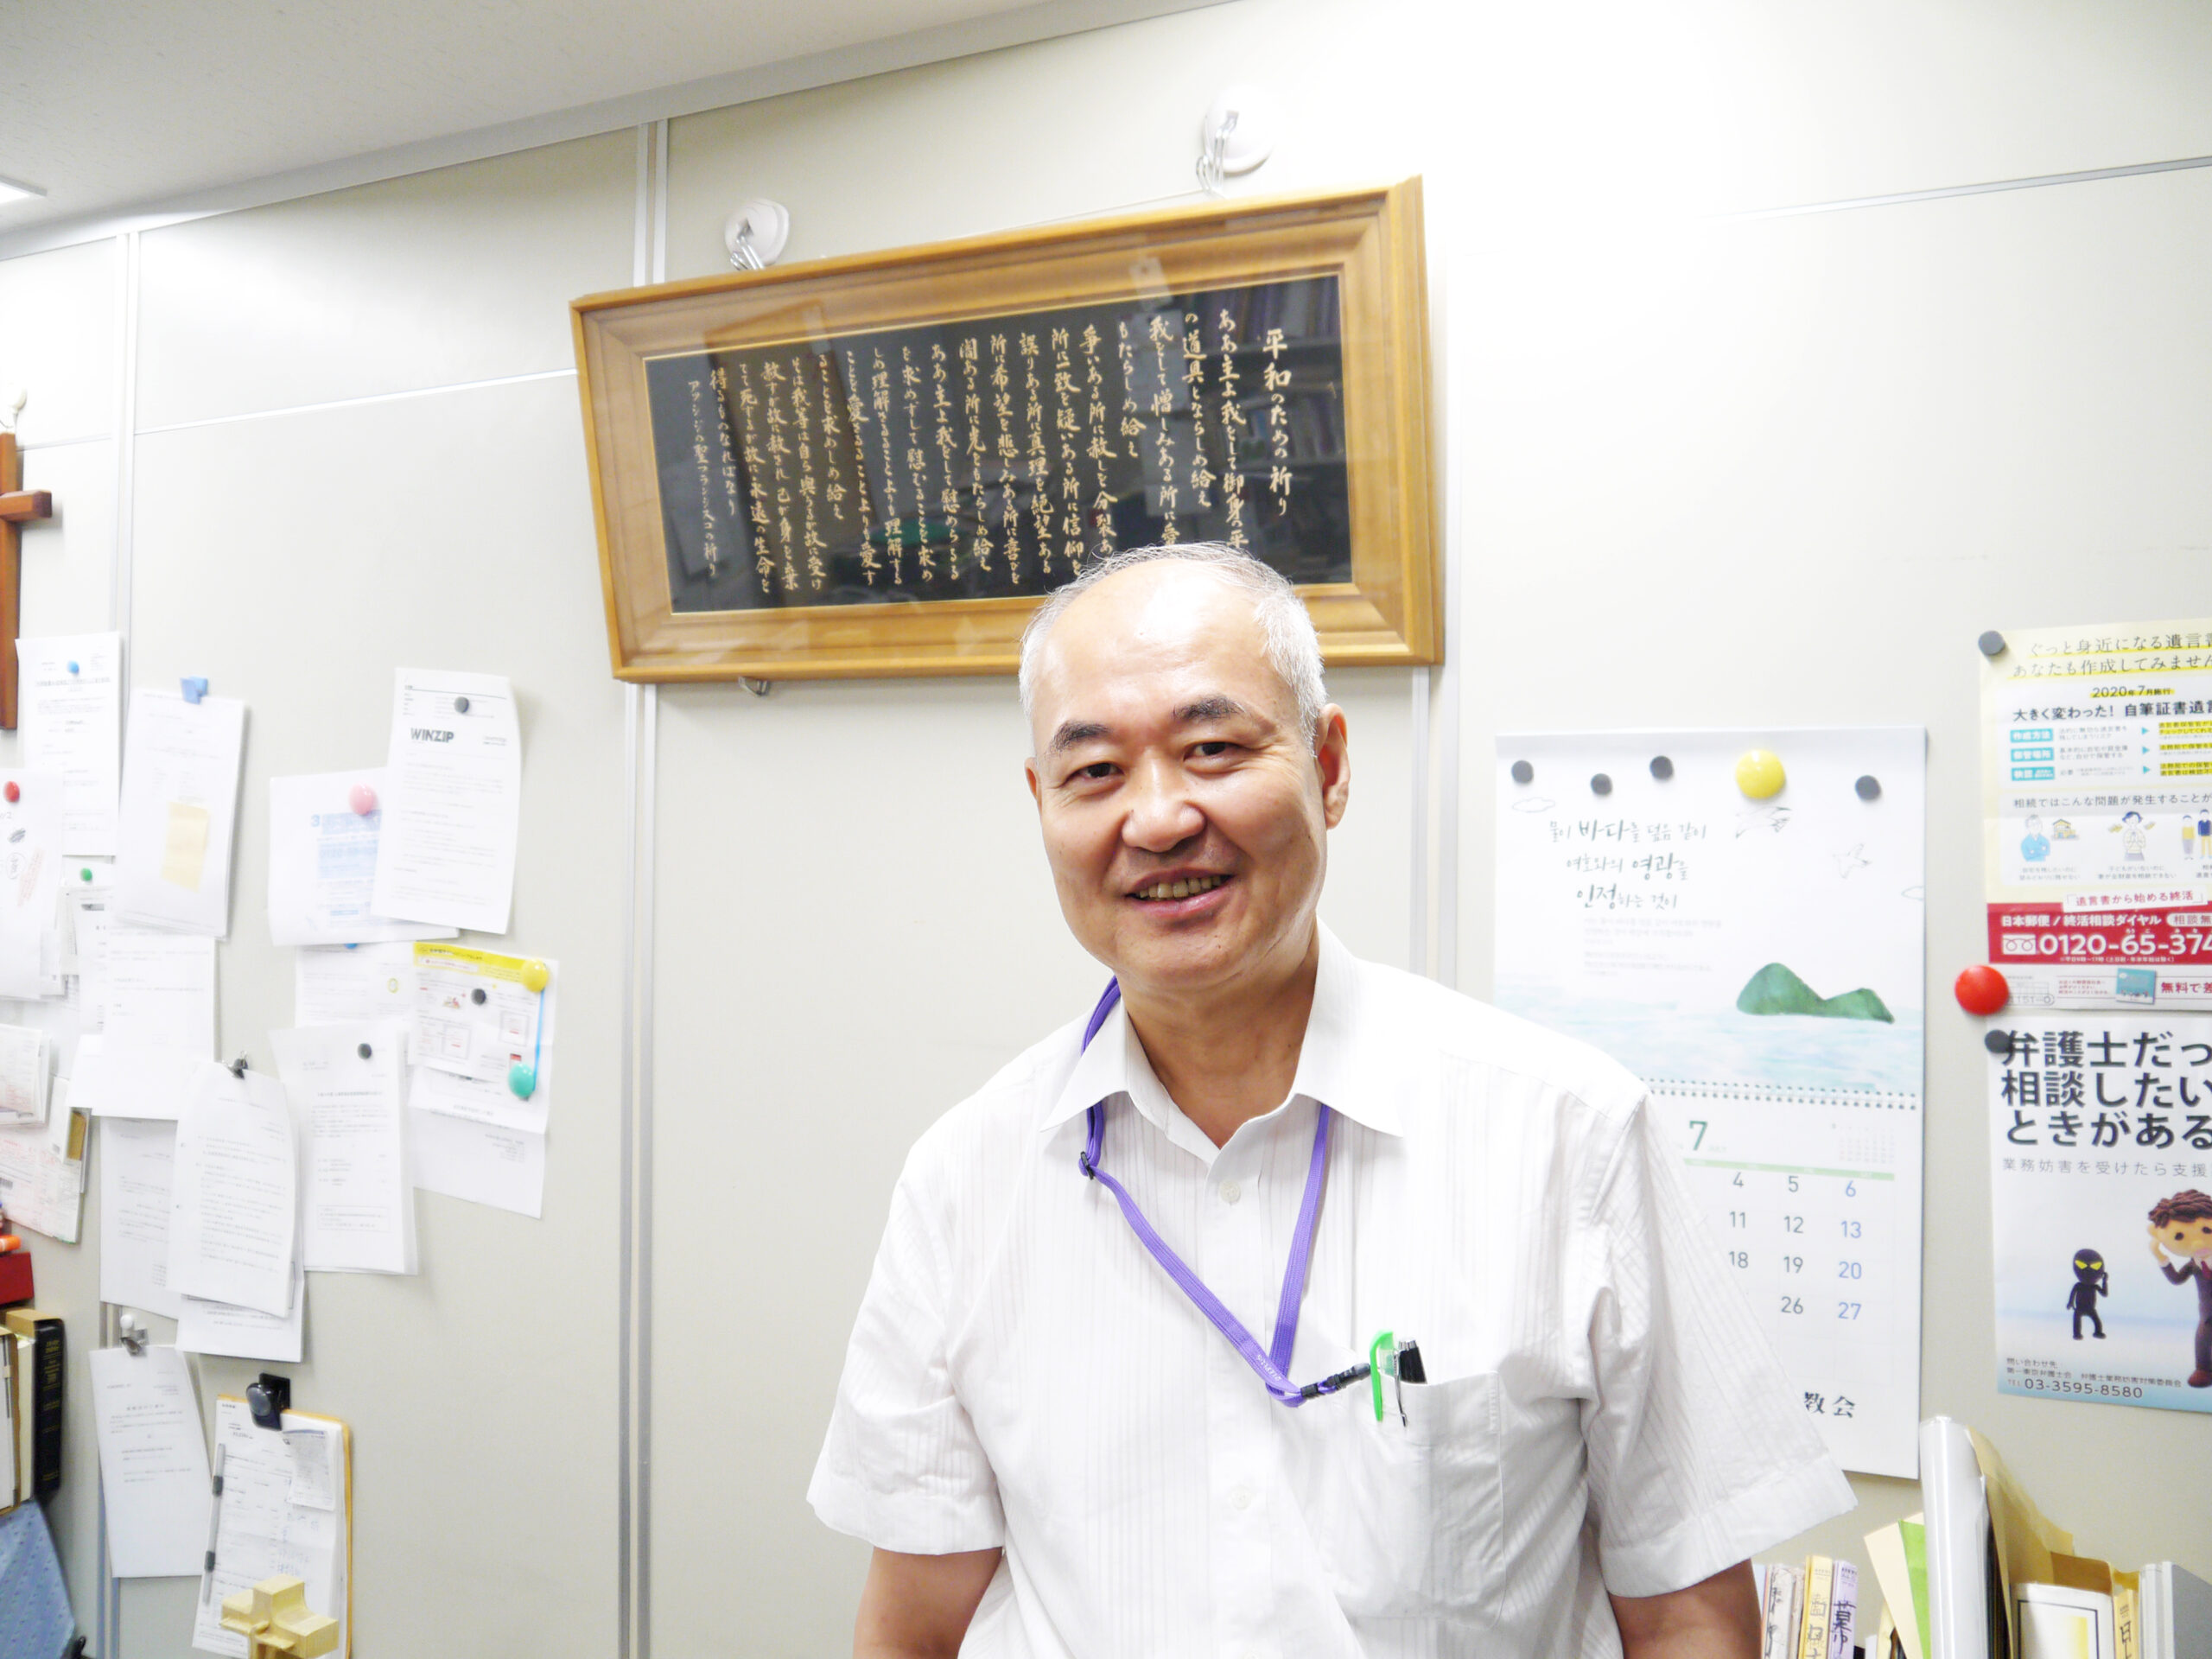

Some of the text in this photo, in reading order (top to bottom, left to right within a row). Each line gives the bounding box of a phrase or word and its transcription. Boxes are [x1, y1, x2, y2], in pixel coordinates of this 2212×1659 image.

[1118, 321, 1147, 459] もたらしめ給え
[1181, 312, 1217, 508] の道具とならしめ給え
[1263, 328, 1292, 516] 平和のための祈り
[410, 728, 455, 743] WINZIP
[1578, 817, 1641, 843] 바다를
[1565, 851, 1689, 881] 여호와의 영광을
[1575, 882, 1679, 911] 인정하는 것이
[2000, 1069, 2212, 1109] 相談したい
[1688, 1120, 1709, 1152] 7
[2005, 1109, 2212, 1150] ときがある
[2002, 1158, 2212, 1178] 業務妨害を受けたら支援
[1732, 1172, 1857, 1198] 4 5 6
[1729, 1211, 1862, 1239] 11 12 13
[1729, 1251, 1862, 1280] 18 19 20
[1781, 1296, 1862, 1321] 26 27
[2024, 1378, 2143, 1399] 03-3595-8580
[1804, 1391, 1857, 1418] 教会
